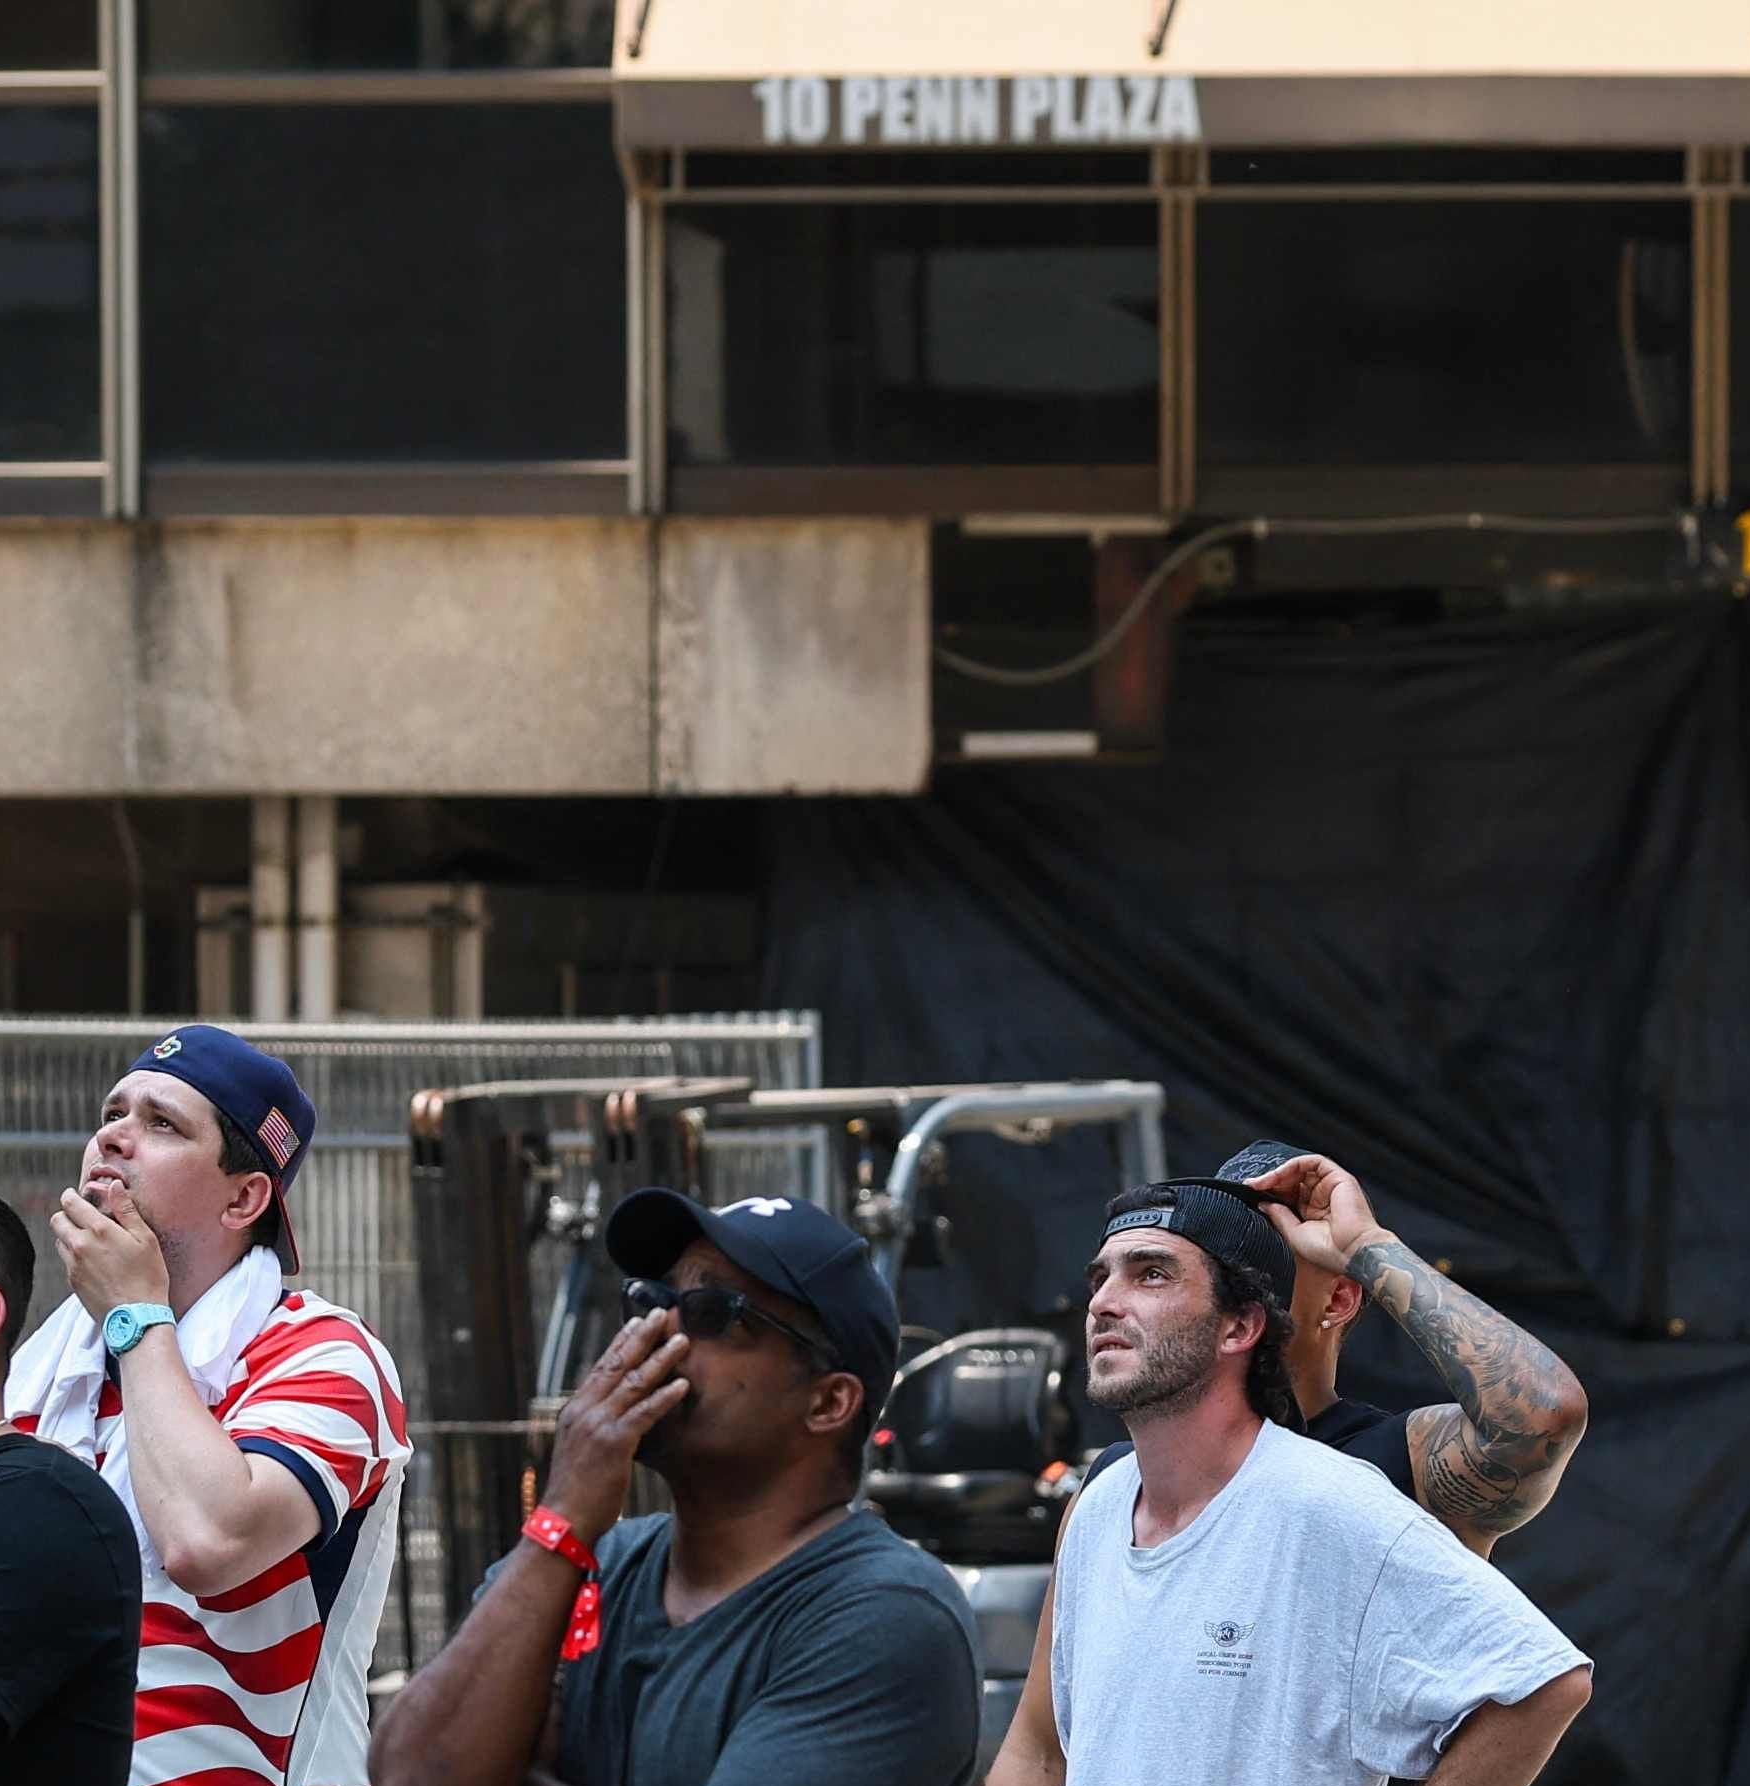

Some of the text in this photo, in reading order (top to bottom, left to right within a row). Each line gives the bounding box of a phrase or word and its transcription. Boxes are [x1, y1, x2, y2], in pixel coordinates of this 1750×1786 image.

[754, 75, 1203, 145] 10 PENN PLAZA
